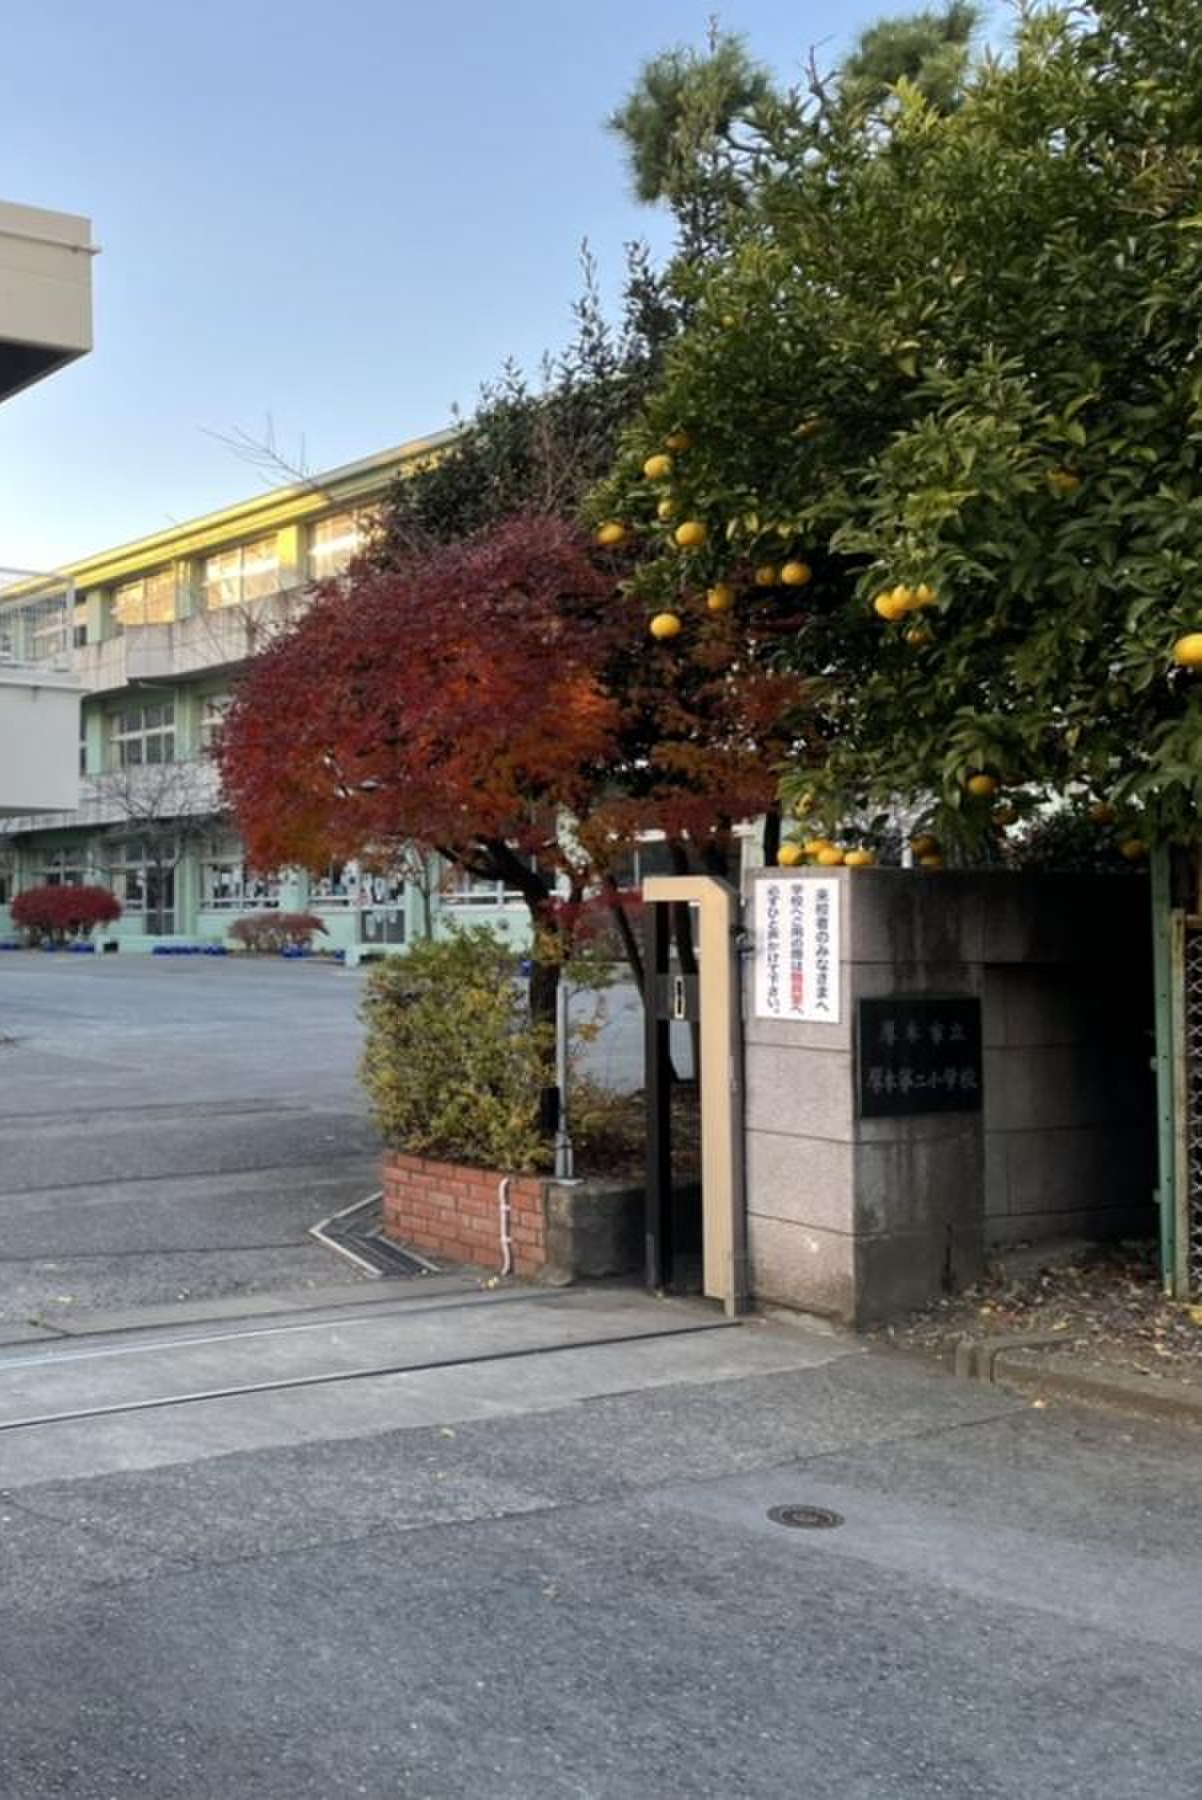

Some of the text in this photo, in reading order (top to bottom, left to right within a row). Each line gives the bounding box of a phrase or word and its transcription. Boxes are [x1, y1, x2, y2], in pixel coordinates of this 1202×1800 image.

[815, 888, 830, 1013] 来校者のみなさまへ
[880, 1020, 966, 1046] 厚木市立
[867, 1067, 976, 1094] 厚木第二小学校
